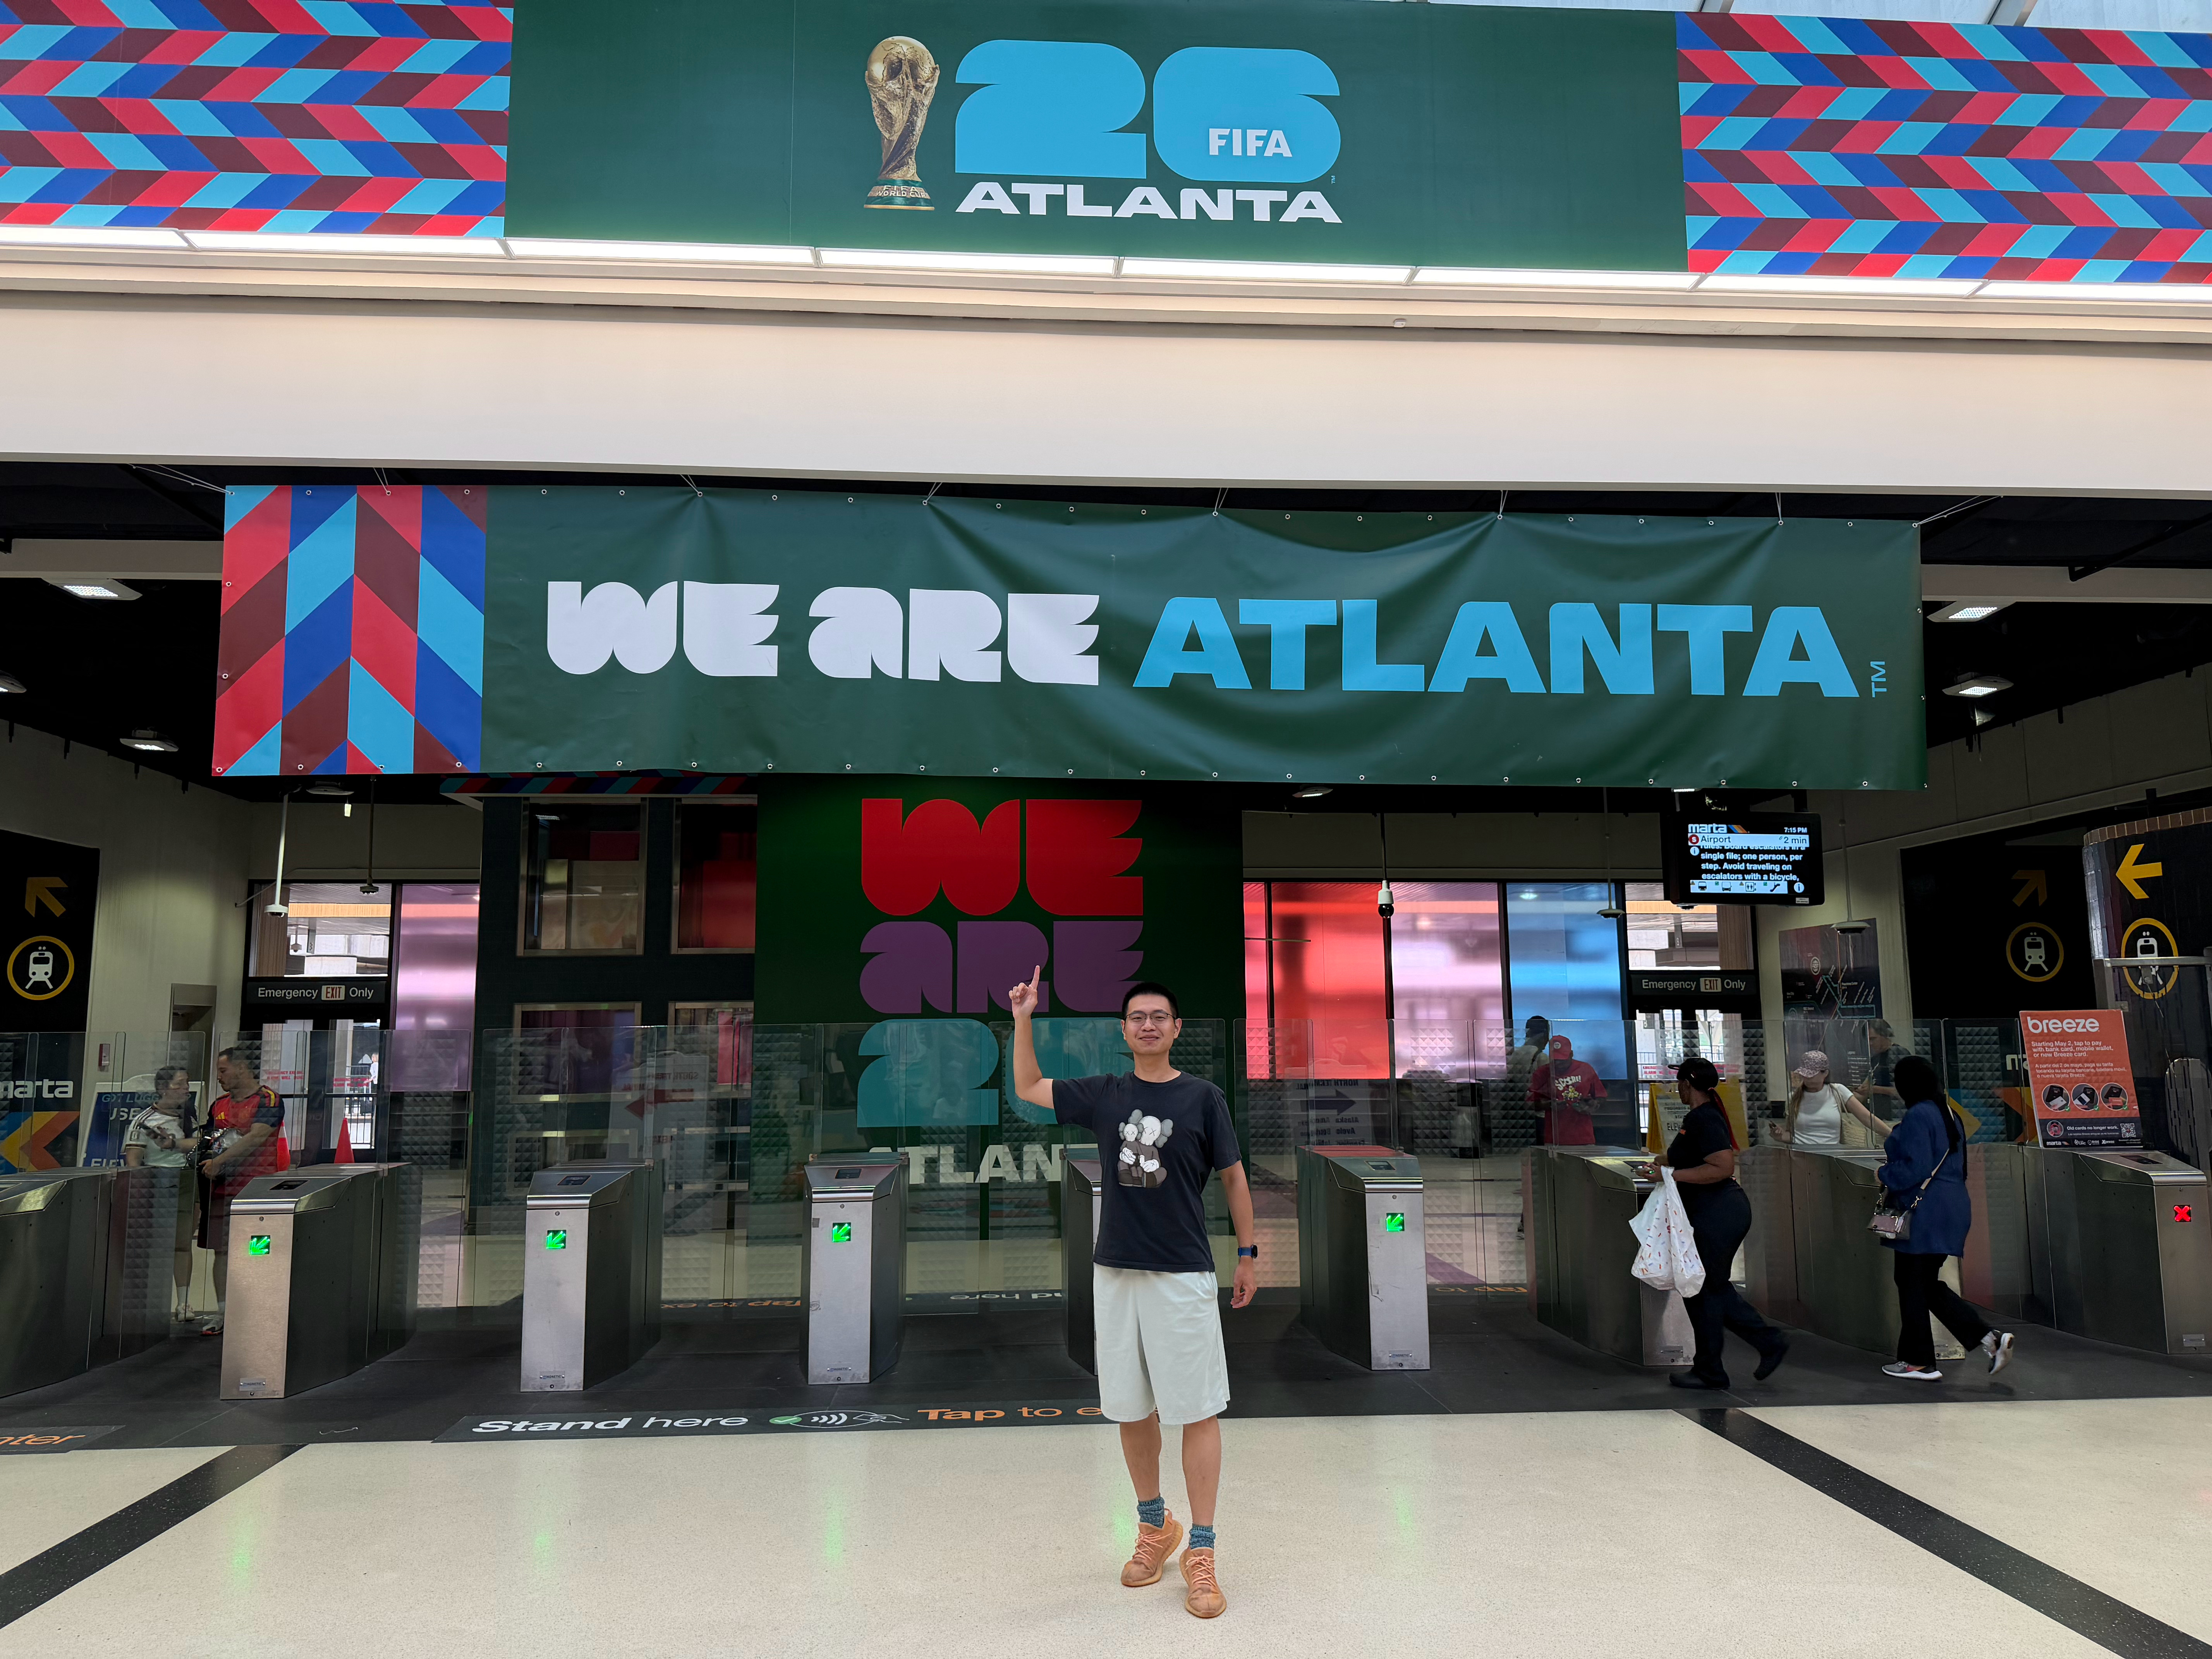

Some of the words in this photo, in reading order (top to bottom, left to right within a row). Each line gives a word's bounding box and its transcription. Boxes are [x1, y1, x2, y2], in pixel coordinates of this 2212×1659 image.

[956, 40, 1341, 183] 26
[1209, 128, 1293, 157] FIFA
[955, 182, 1343, 223] ATLANTA
[547, 581, 779, 677] WE
[1134, 598, 1859, 697] ATLANTA
[1870, 661, 1887, 698] TM
[1688, 823, 1727, 833] marta
[862, 799, 1144, 916] WE
[1700, 852, 1724, 860] single
[1726, 852, 1741, 860] file;
[1701, 862, 1721, 871] step.
[1747, 863, 1780, 871] traveling
[1769, 873, 1799, 882] bicycle,
[258, 988, 318, 999] Emergency
[326, 987, 342, 999] EXIT
[349, 987, 374, 999] Only
[1642, 979, 1697, 991] Emergency
[1704, 979, 1718, 990] EXIT
[1724, 979, 1746, 991] Only
[2027, 1016, 2099, 1033] breeze
[472, 1417, 632, 1432] Stand
[642, 1415, 749, 1428] here
[917, 1408, 1005, 1421] Tap
[1018, 1407, 1063, 1417] to
